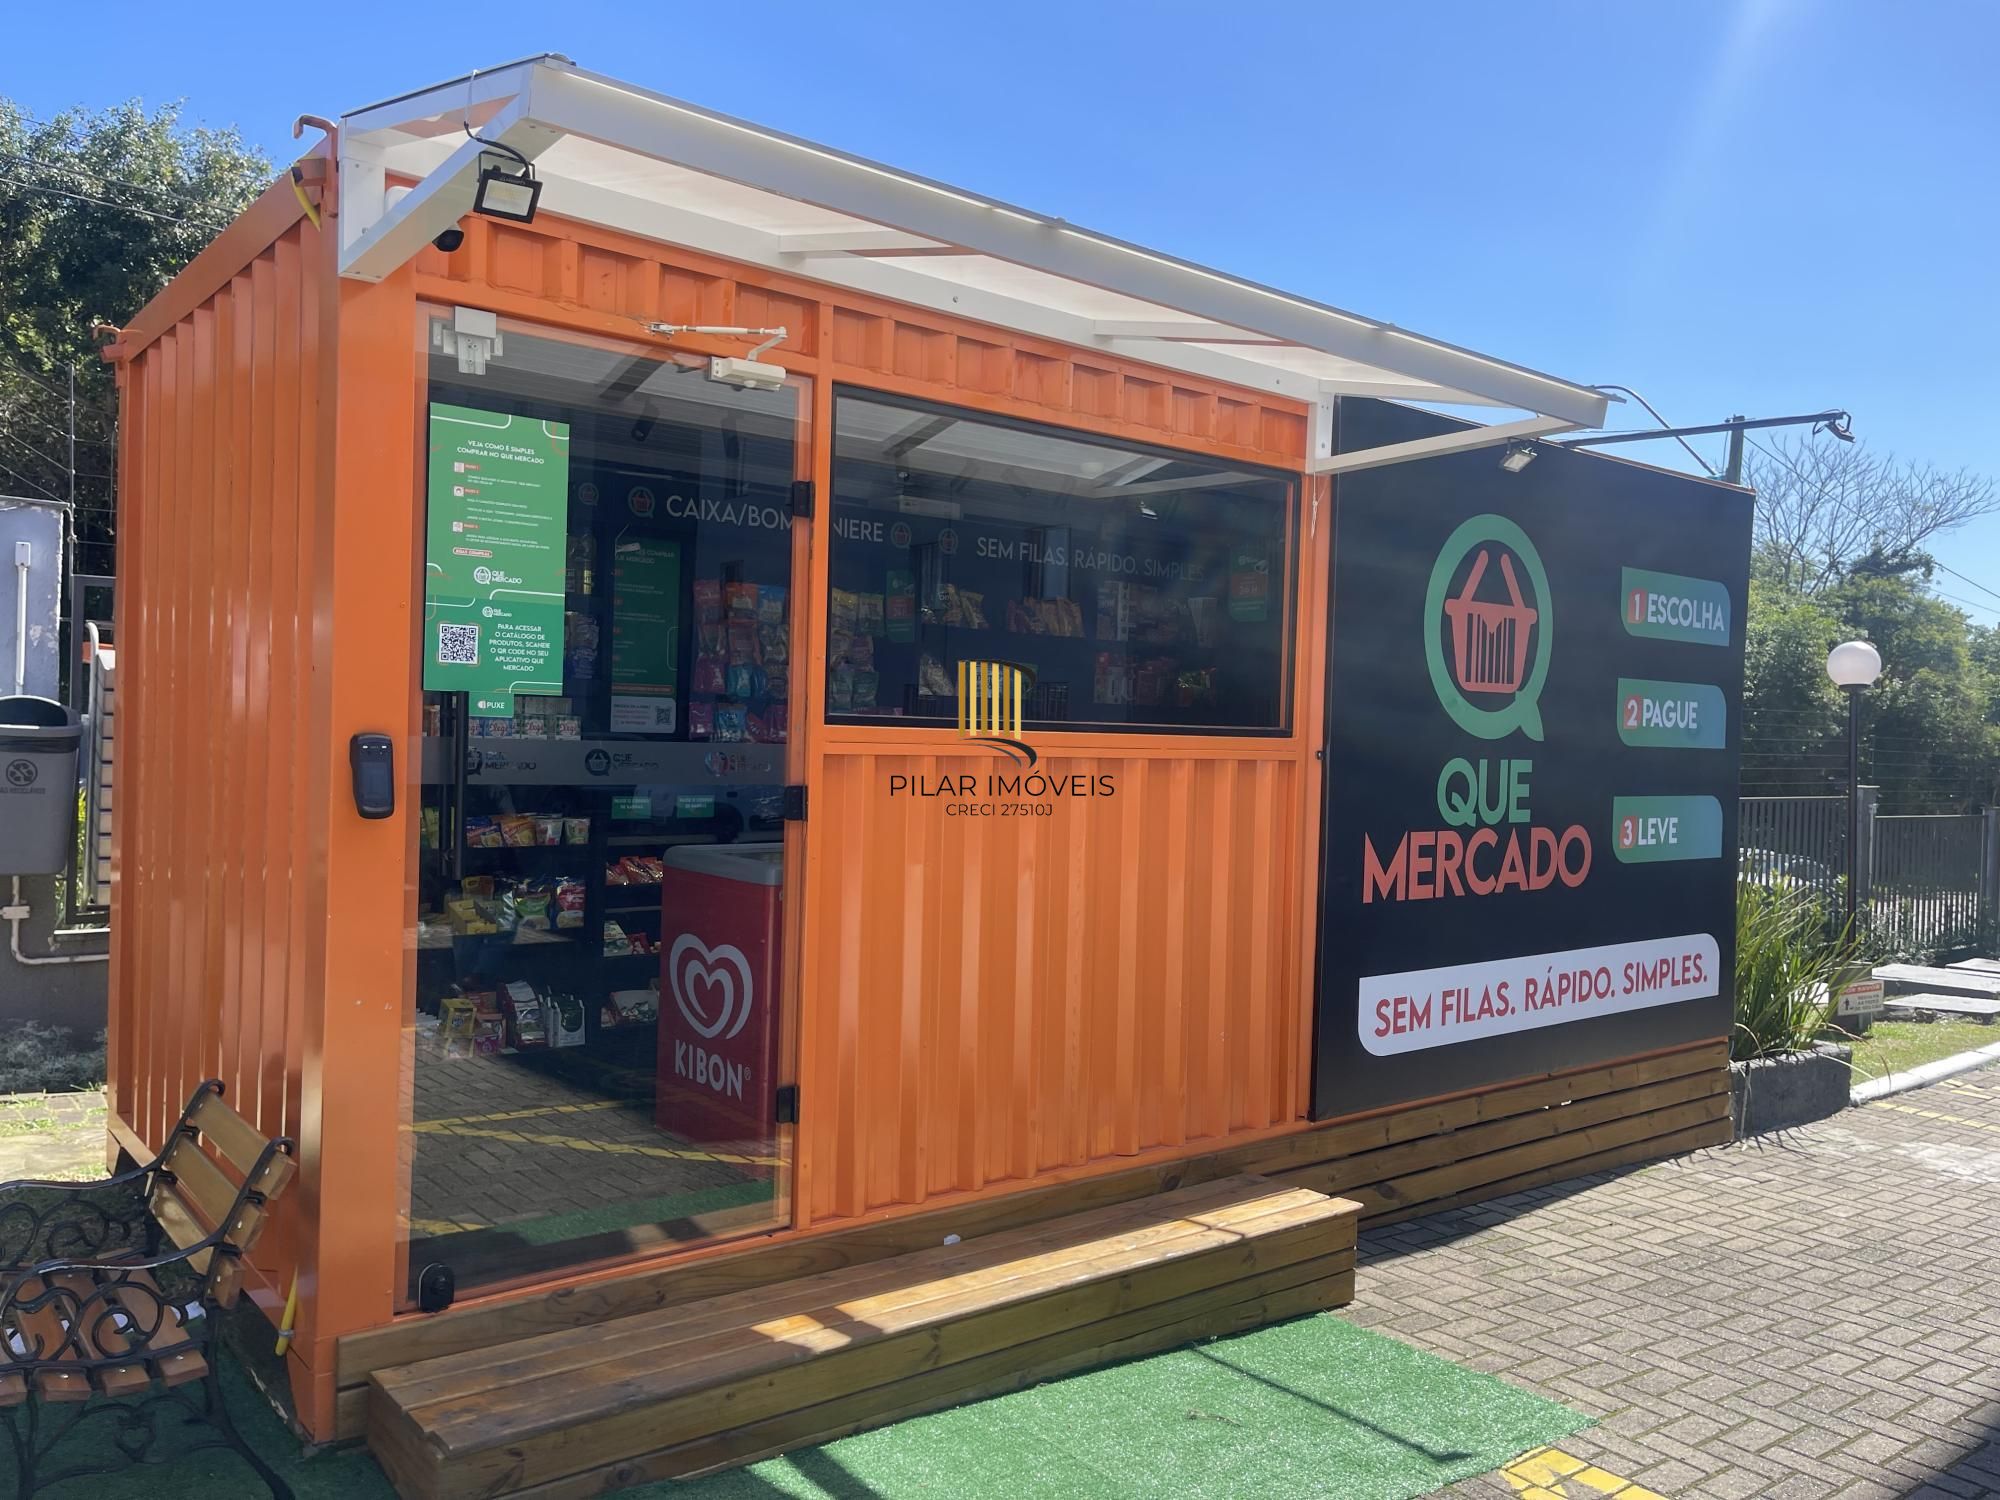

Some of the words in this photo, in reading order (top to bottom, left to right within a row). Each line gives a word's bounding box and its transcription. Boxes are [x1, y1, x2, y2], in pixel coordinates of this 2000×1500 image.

[457, 447, 488, 457] COMPRAR
[500, 452, 513, 460] QUE
[514, 455, 545, 464] MERCADO
[484, 442, 504, 451] COMO
[511, 446, 535, 455] SIMPLES
[976, 536, 1013, 559] SEM
[1019, 542, 1069, 567] FILAS.
[1075, 546, 1138, 575] RÁPIDO.
[492, 576, 522, 585] MERCADO
[1634, 593, 1641, 621] 1
[1647, 593, 1725, 632] ESCOLHA
[497, 623, 514, 631] PARA
[514, 625, 542, 633] ACESSAR
[494, 656, 531, 664] APLICATIVO
[531, 657, 545, 665] QUE
[497, 647, 507, 655] QR
[507, 648, 526, 656] CODE
[503, 664, 535, 672] MERCADO
[486, 701, 505, 709] PUXE
[1627, 699, 1638, 727] 2
[1642, 698, 1698, 729] PAGUE
[1437, 757, 1532, 828] QUE
[1623, 819, 1633, 846] 3
[1638, 817, 1678, 846] LEVE
[1363, 824, 1592, 904] MERCADO
[1374, 992, 1432, 1038] SEM
[1441, 981, 1516, 1026] FILAS.
[1524, 965, 1616, 1012] RÁPIDO.
[1622, 952, 1708, 995] SIMPLES.
[674, 1039, 743, 1103] KIBON
